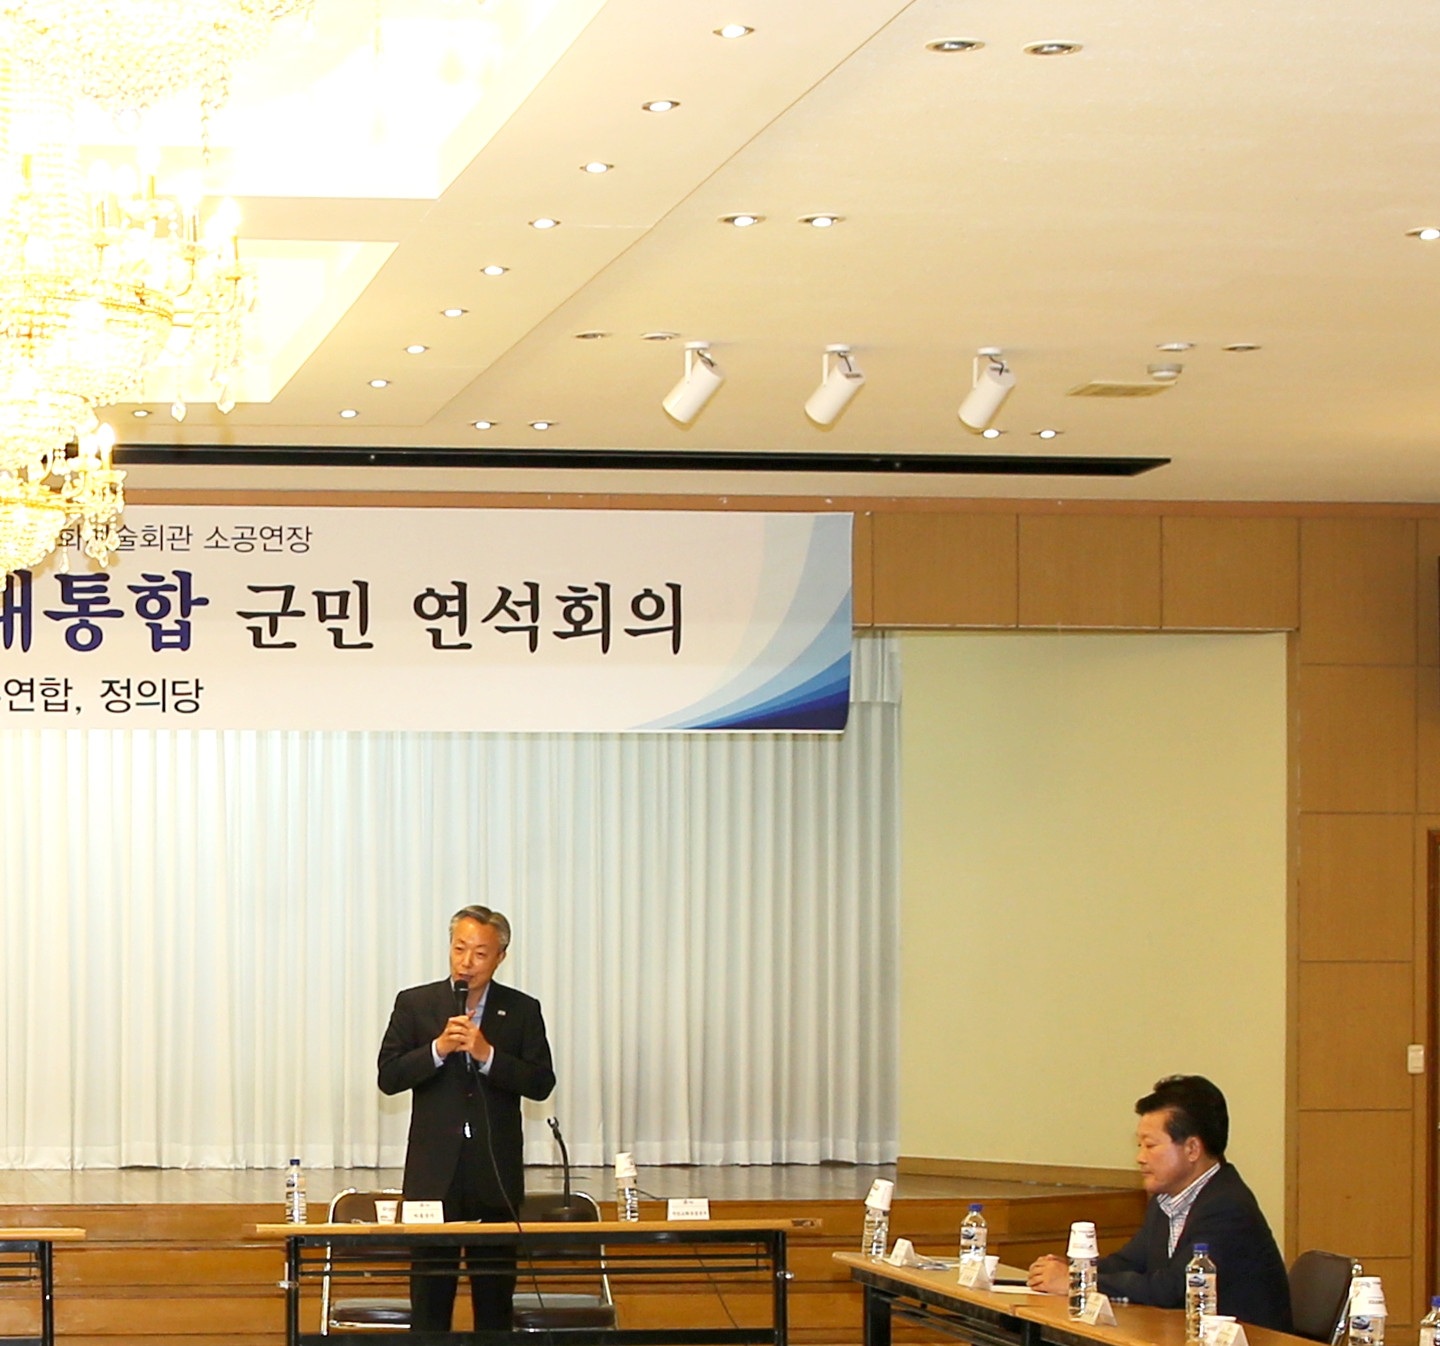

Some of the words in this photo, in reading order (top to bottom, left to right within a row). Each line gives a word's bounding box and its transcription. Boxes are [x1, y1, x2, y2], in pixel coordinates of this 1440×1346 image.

[204, 525, 313, 554] 소공연장
[236, 580, 374, 649] 군민
[413, 580, 682, 655] 연석회의
[100, 678, 204, 714] 정의당
